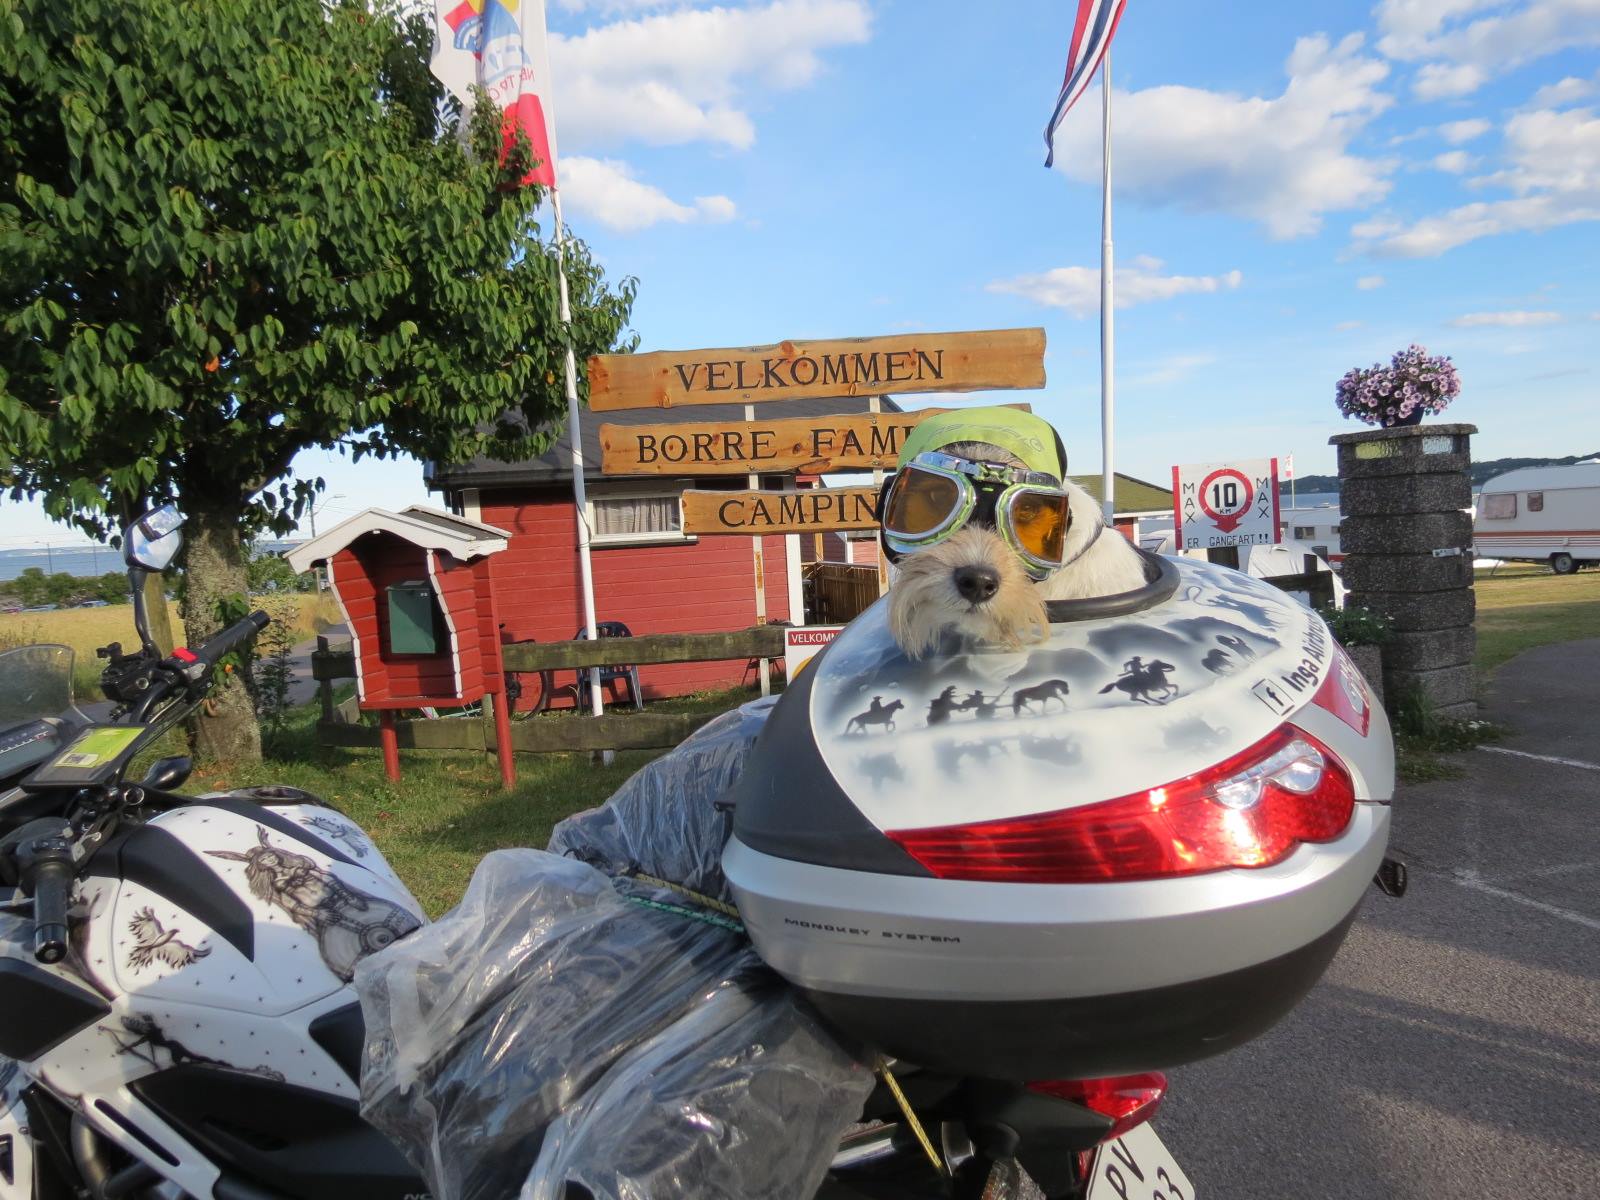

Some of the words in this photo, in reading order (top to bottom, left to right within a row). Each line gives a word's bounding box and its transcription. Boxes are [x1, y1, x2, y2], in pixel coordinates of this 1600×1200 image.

[675, 350, 944, 392] VELKOMMEN
[636, 430, 777, 463] BORRE
[810, 423, 914, 457] FAMI
[718, 492, 880, 527] CAMPIN
[1213, 483, 1237, 508] 10
[1187, 537, 1199, 548] ER
[791, 632, 838, 643] VELKOM
[1281, 659, 1319, 692] Inga
[784, 917, 870, 936] MONOKEY
[881, 931, 960, 943] SYSTEM
